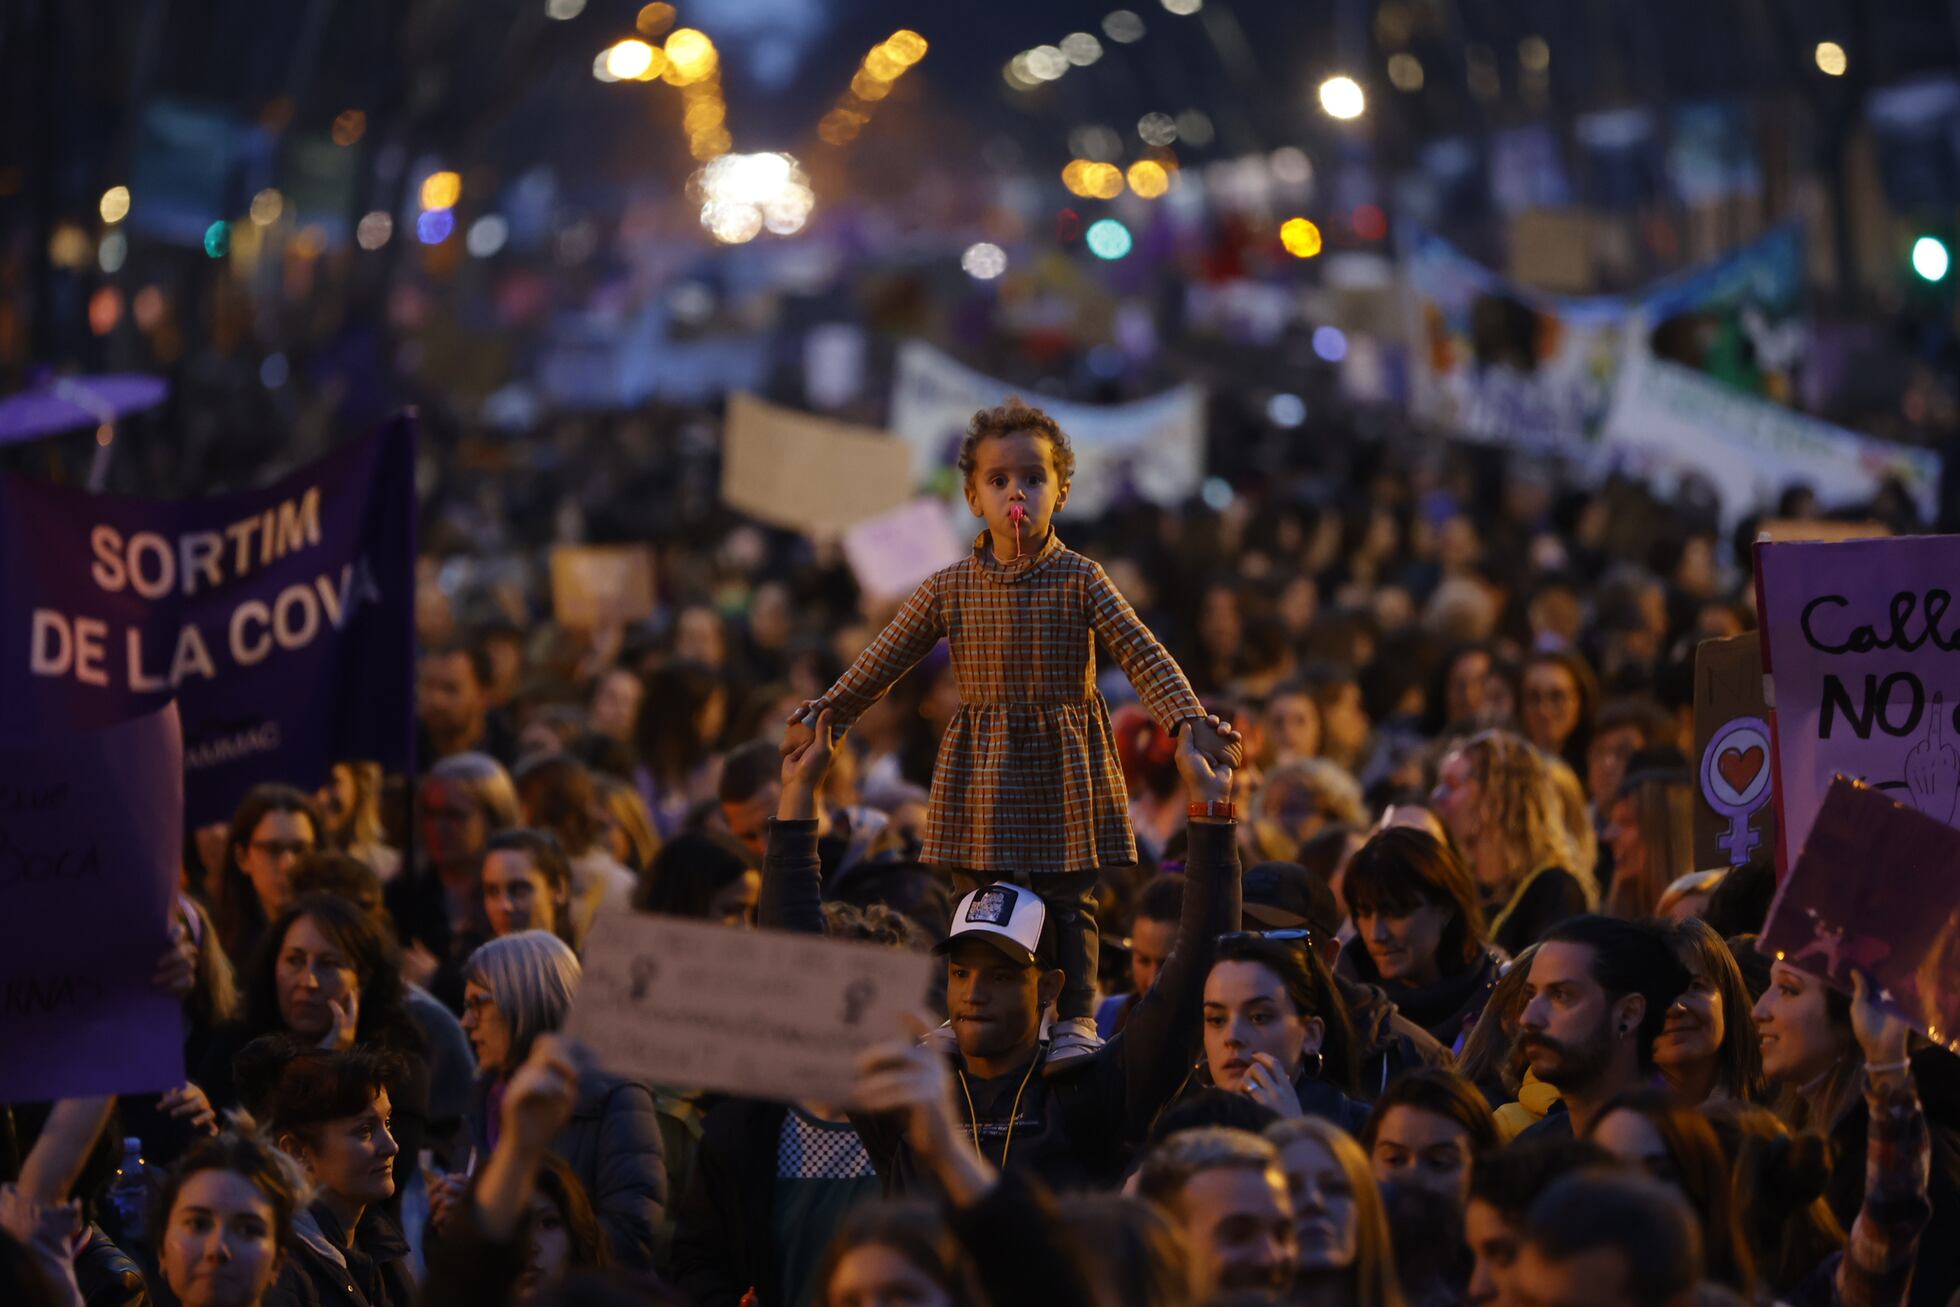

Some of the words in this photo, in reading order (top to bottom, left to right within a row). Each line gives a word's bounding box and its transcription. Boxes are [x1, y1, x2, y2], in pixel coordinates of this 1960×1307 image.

[90, 486, 323, 599] SORTIM
[30, 607, 110, 687] DE
[126, 622, 217, 694] LA
[1818, 671, 1925, 739] NO
